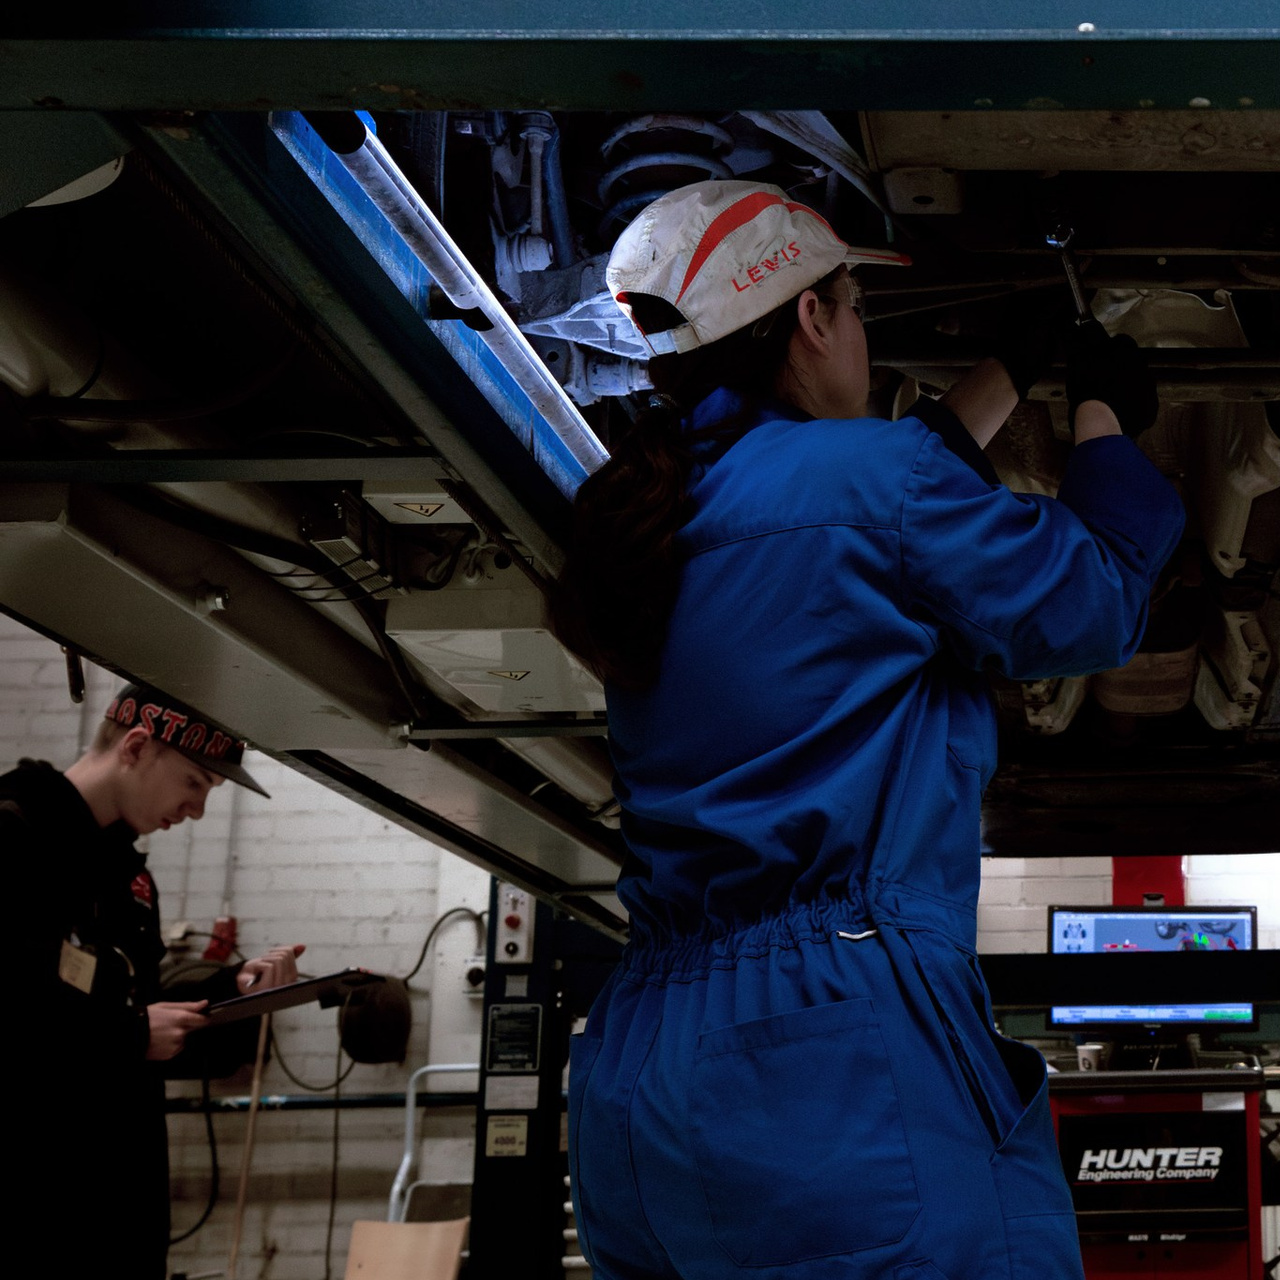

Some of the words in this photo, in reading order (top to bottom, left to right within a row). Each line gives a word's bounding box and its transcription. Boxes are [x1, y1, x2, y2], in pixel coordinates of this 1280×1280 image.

[1080, 1147, 1222, 1169] HUNTER
[1077, 1168, 1154, 1182] Engineering
[1156, 1167, 1219, 1180] Company
